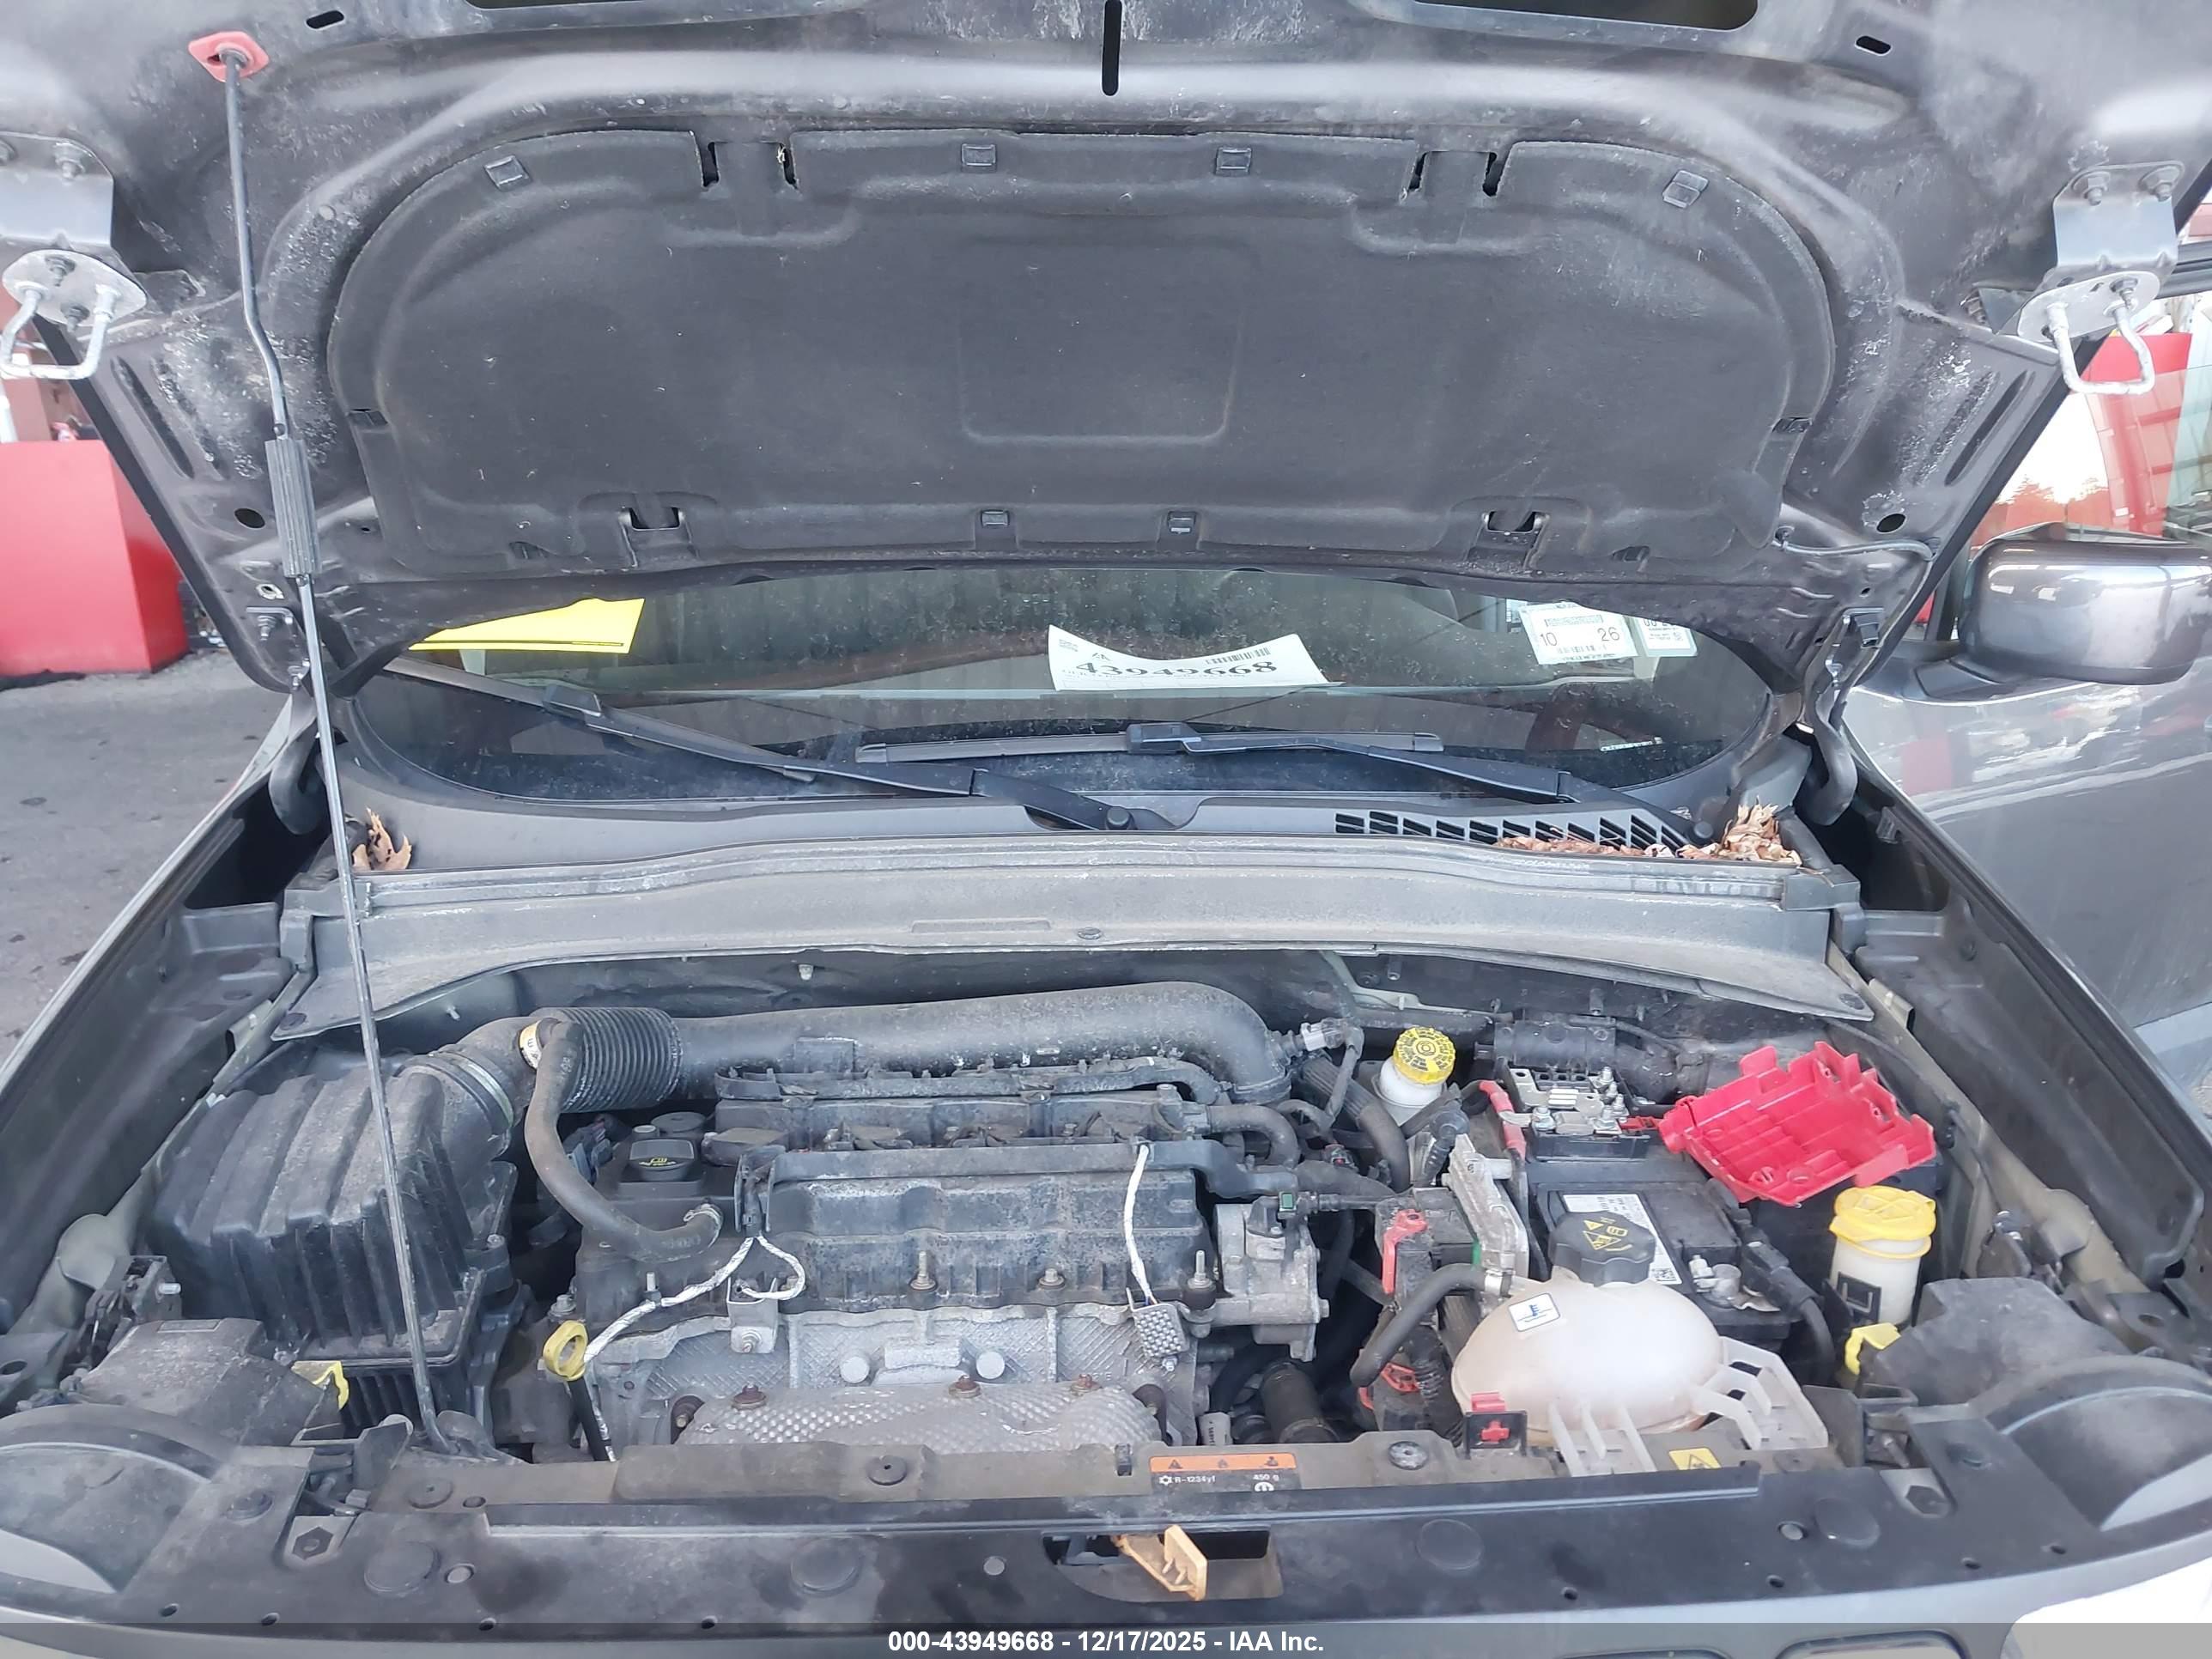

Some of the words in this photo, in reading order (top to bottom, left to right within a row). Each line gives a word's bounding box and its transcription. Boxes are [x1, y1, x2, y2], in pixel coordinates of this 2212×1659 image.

[1540, 632, 1558, 647] 10
[1597, 626, 1620, 641] 26
[1076, 660, 1277, 676] 43949668
